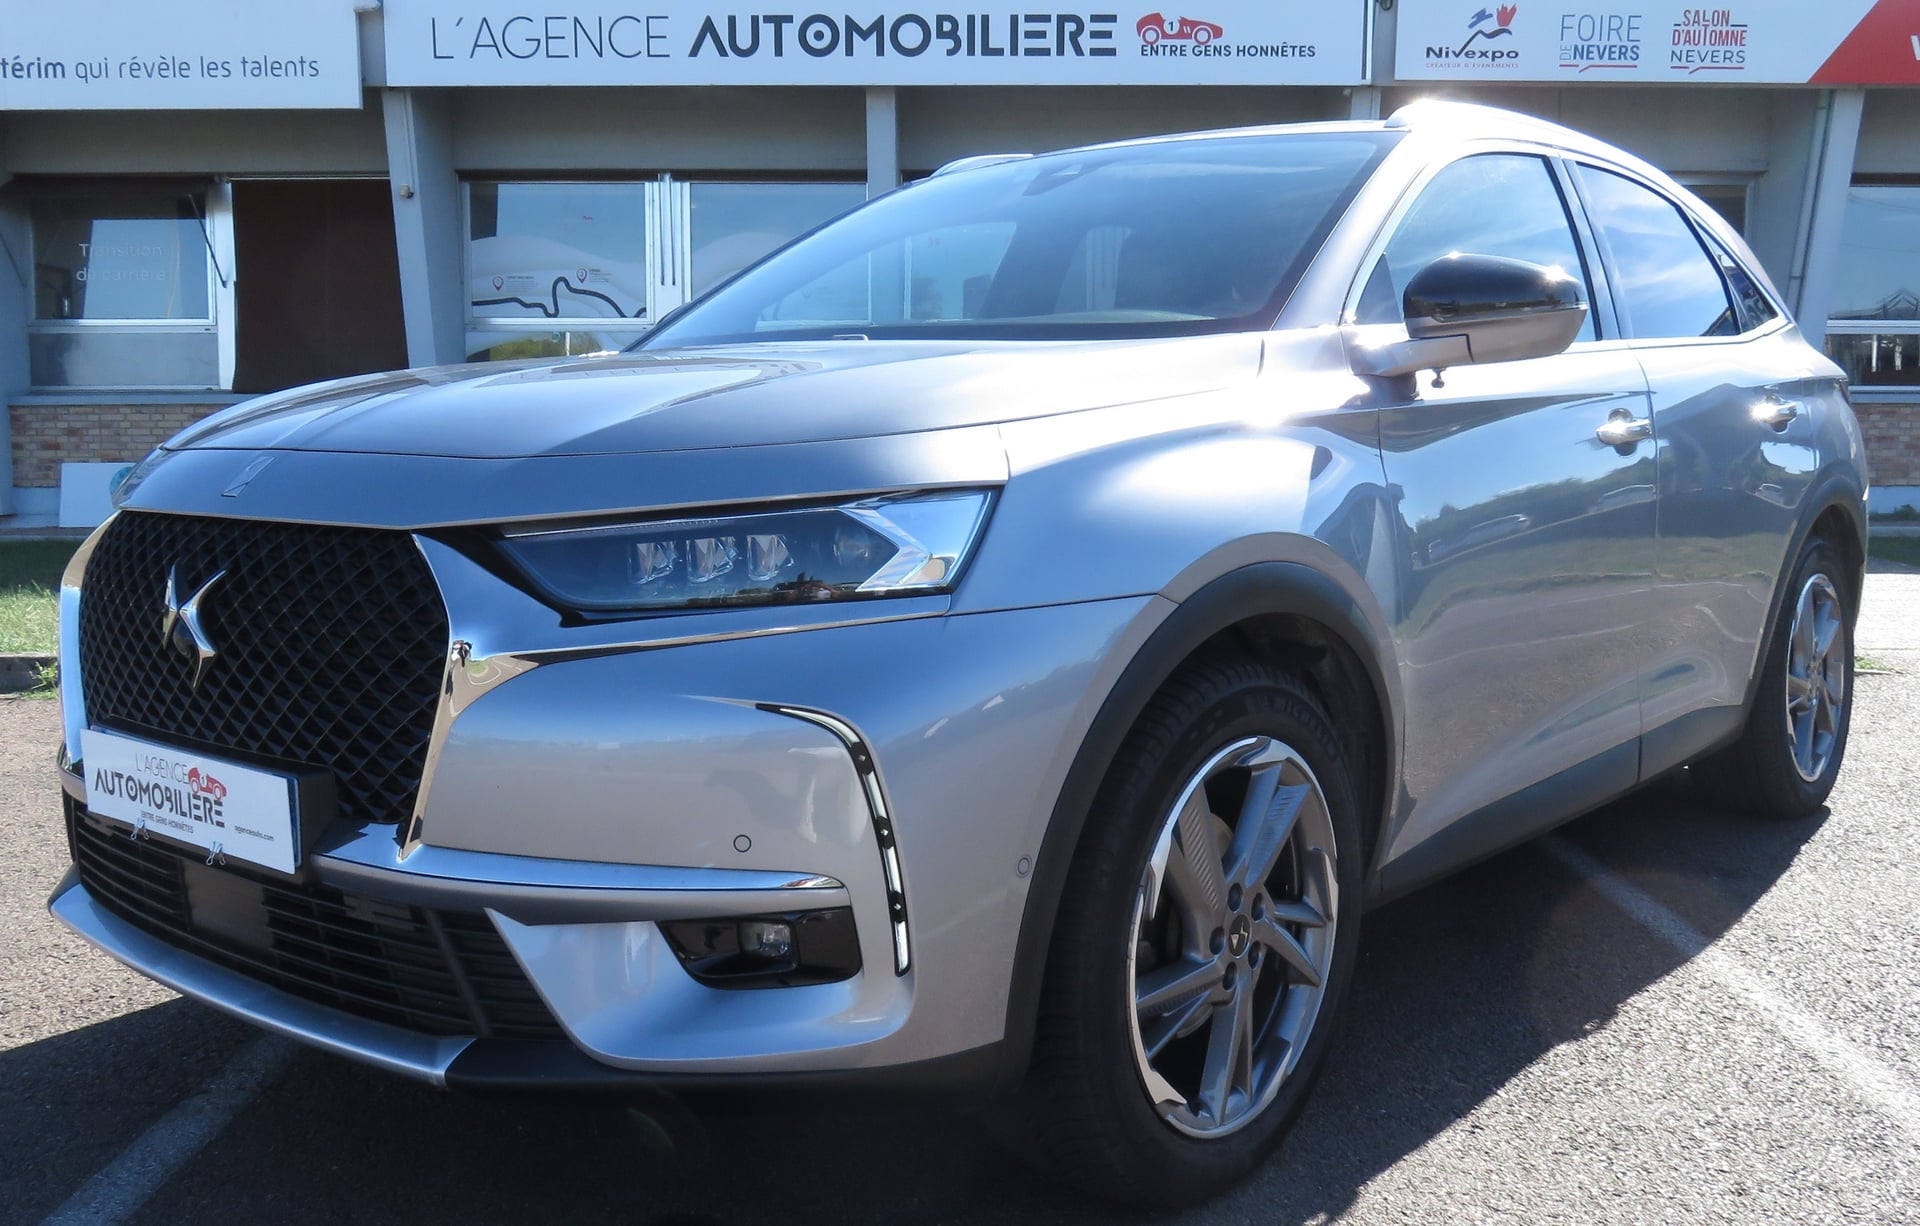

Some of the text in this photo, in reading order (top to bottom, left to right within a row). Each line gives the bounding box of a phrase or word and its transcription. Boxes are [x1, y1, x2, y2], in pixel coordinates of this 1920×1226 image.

[1560, 14, 1642, 42] FOIRE
[1682, 9, 1730, 27] SALON
[431, 13, 1119, 59] L'AGENCE AUTOMOBILIERE
[1671, 24, 1748, 47] D'AUTOMNE
[1140, 41, 1316, 58] ENTRE GENS HONNÊTES
[1425, 46, 1519, 62] Nivexpo
[1572, 44, 1640, 61] NEVERS
[1670, 49, 1746, 64] NEVERS
[0, 55, 320, 84] térim qui révèle les talents
[94, 767, 225, 828] AUTOMOBILIERE
